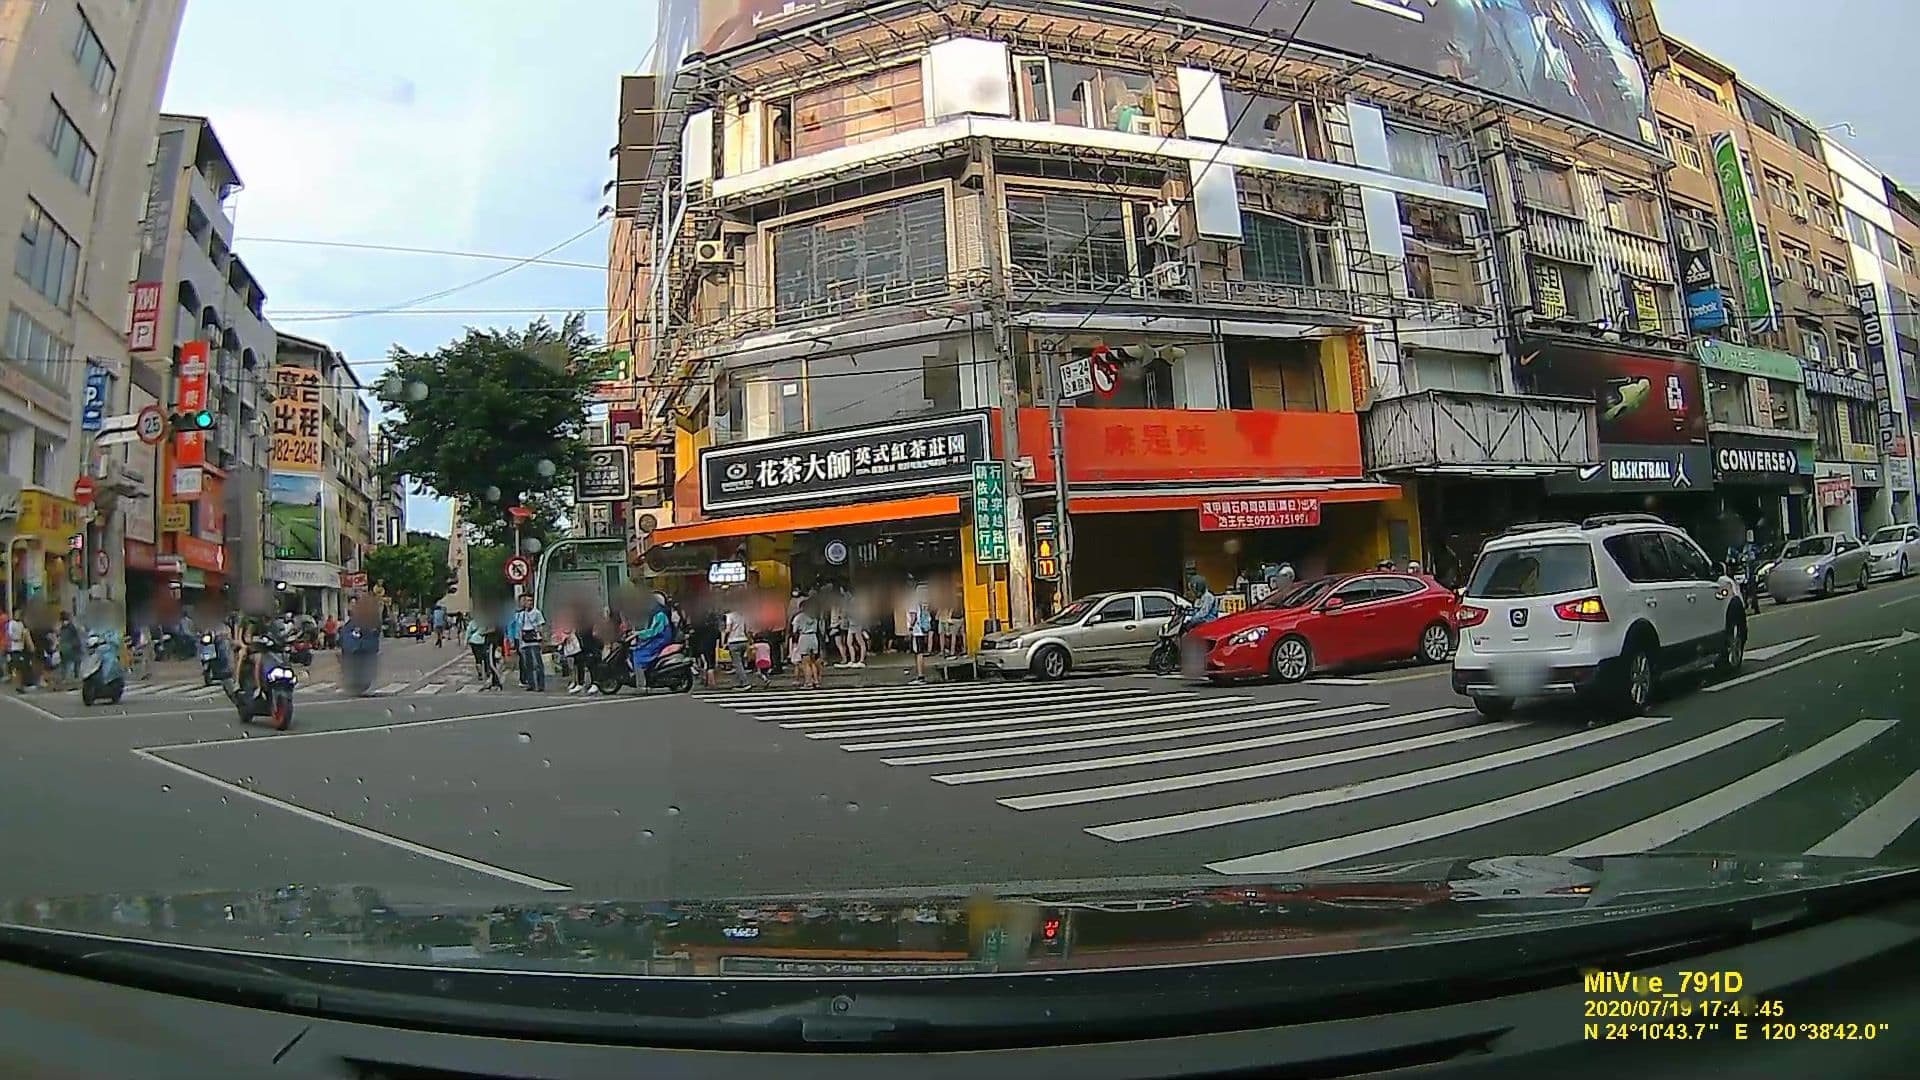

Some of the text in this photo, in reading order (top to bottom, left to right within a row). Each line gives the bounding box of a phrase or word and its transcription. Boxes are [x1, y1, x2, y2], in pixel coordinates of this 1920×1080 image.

[144, 418, 159, 434] 25
[274, 405, 319, 437] 出租
[855, 434, 966, 467] 英式紅茶莊園
[1719, 449, 1786, 472] CONVERSE
[757, 449, 851, 488] 花茶大師
[1611, 460, 1671, 480] BASKETBALL
[990, 466, 1006, 560] 行人穿越路口
